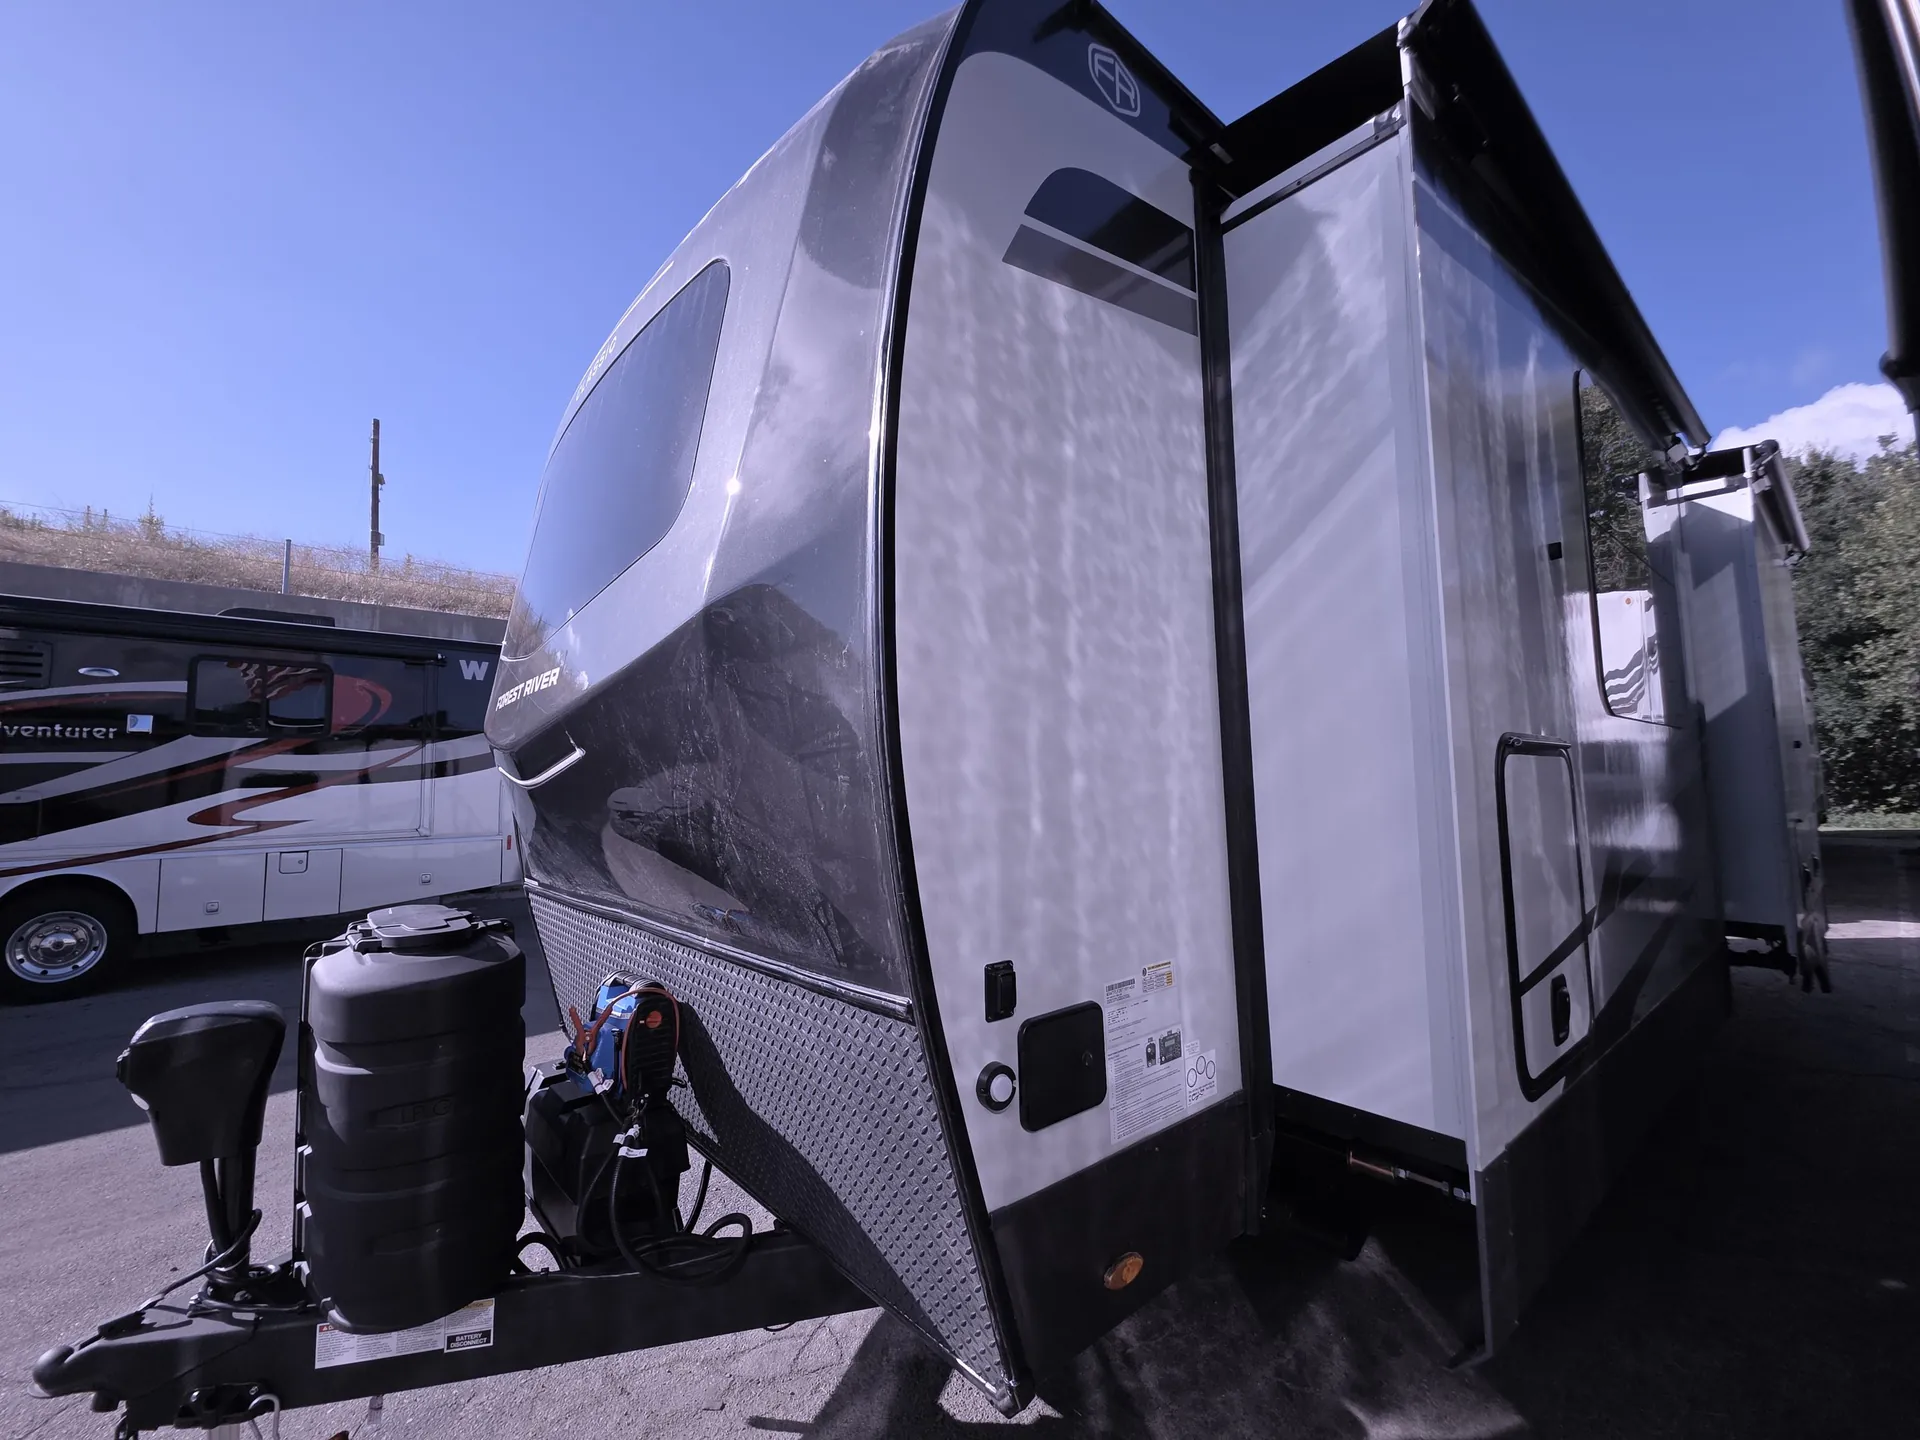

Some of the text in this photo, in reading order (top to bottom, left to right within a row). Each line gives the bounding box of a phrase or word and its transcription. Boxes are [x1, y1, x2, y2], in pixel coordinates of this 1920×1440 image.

[459, 659, 489, 681] W
[495, 666, 560, 712] FOREST RIVER
[0, 721, 118, 739] venturer
[450, 1337, 487, 1348] DISCONNECT
[455, 1332, 483, 1342] BATTERY
